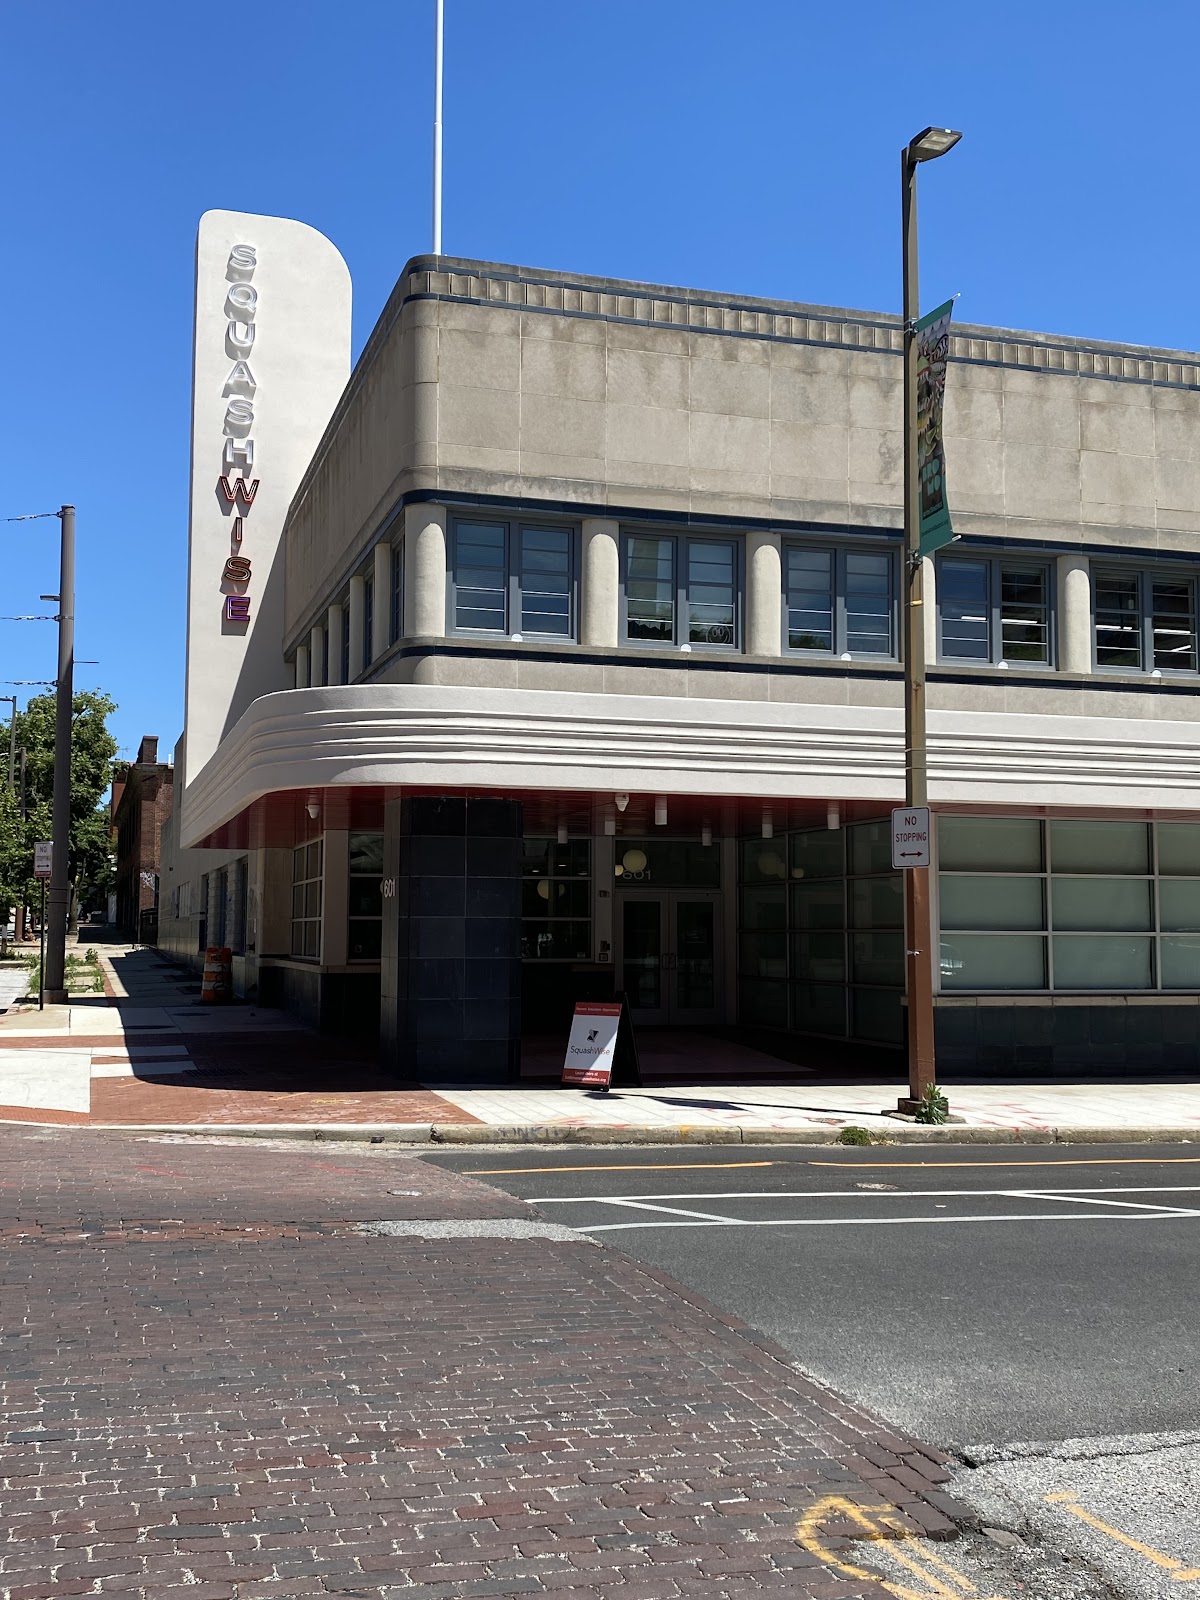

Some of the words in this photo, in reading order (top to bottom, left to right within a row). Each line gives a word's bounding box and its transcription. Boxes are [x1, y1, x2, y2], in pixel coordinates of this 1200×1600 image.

[904, 815, 918, 826] NO
[895, 831, 927, 843] STOPPING
[622, 869, 651, 880] 601
[383, 878, 396, 898] 601
[570, 1045, 611, 1056] SquashWise
